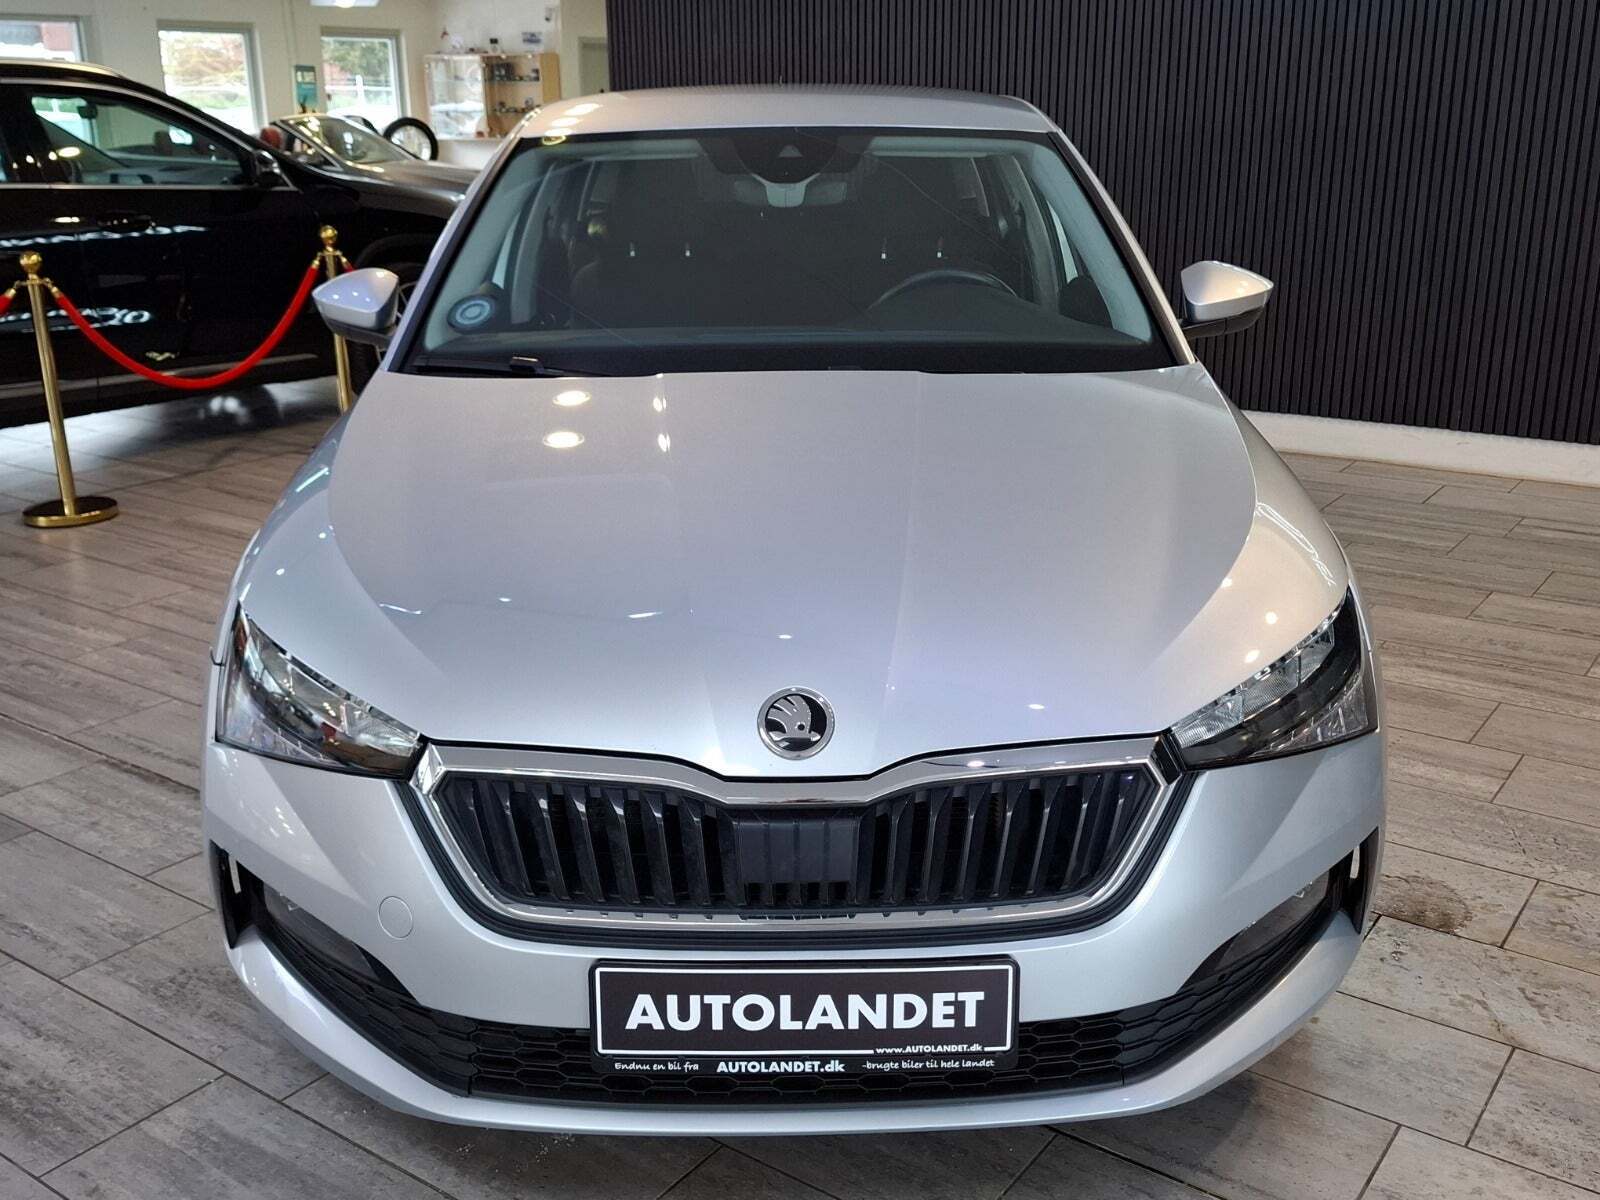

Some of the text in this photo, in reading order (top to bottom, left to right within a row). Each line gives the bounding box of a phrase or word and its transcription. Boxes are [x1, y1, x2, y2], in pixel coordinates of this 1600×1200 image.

[624, 991, 985, 1032] AUTOLANDET
[875, 1043, 983, 1054] www.AUTOLANDET.dk
[614, 1061, 699, 1073] Endnu en bil fra
[716, 1059, 846, 1074] AUTOLANDET.dk
[862, 1058, 996, 1072] -brugte biler til hele landet
